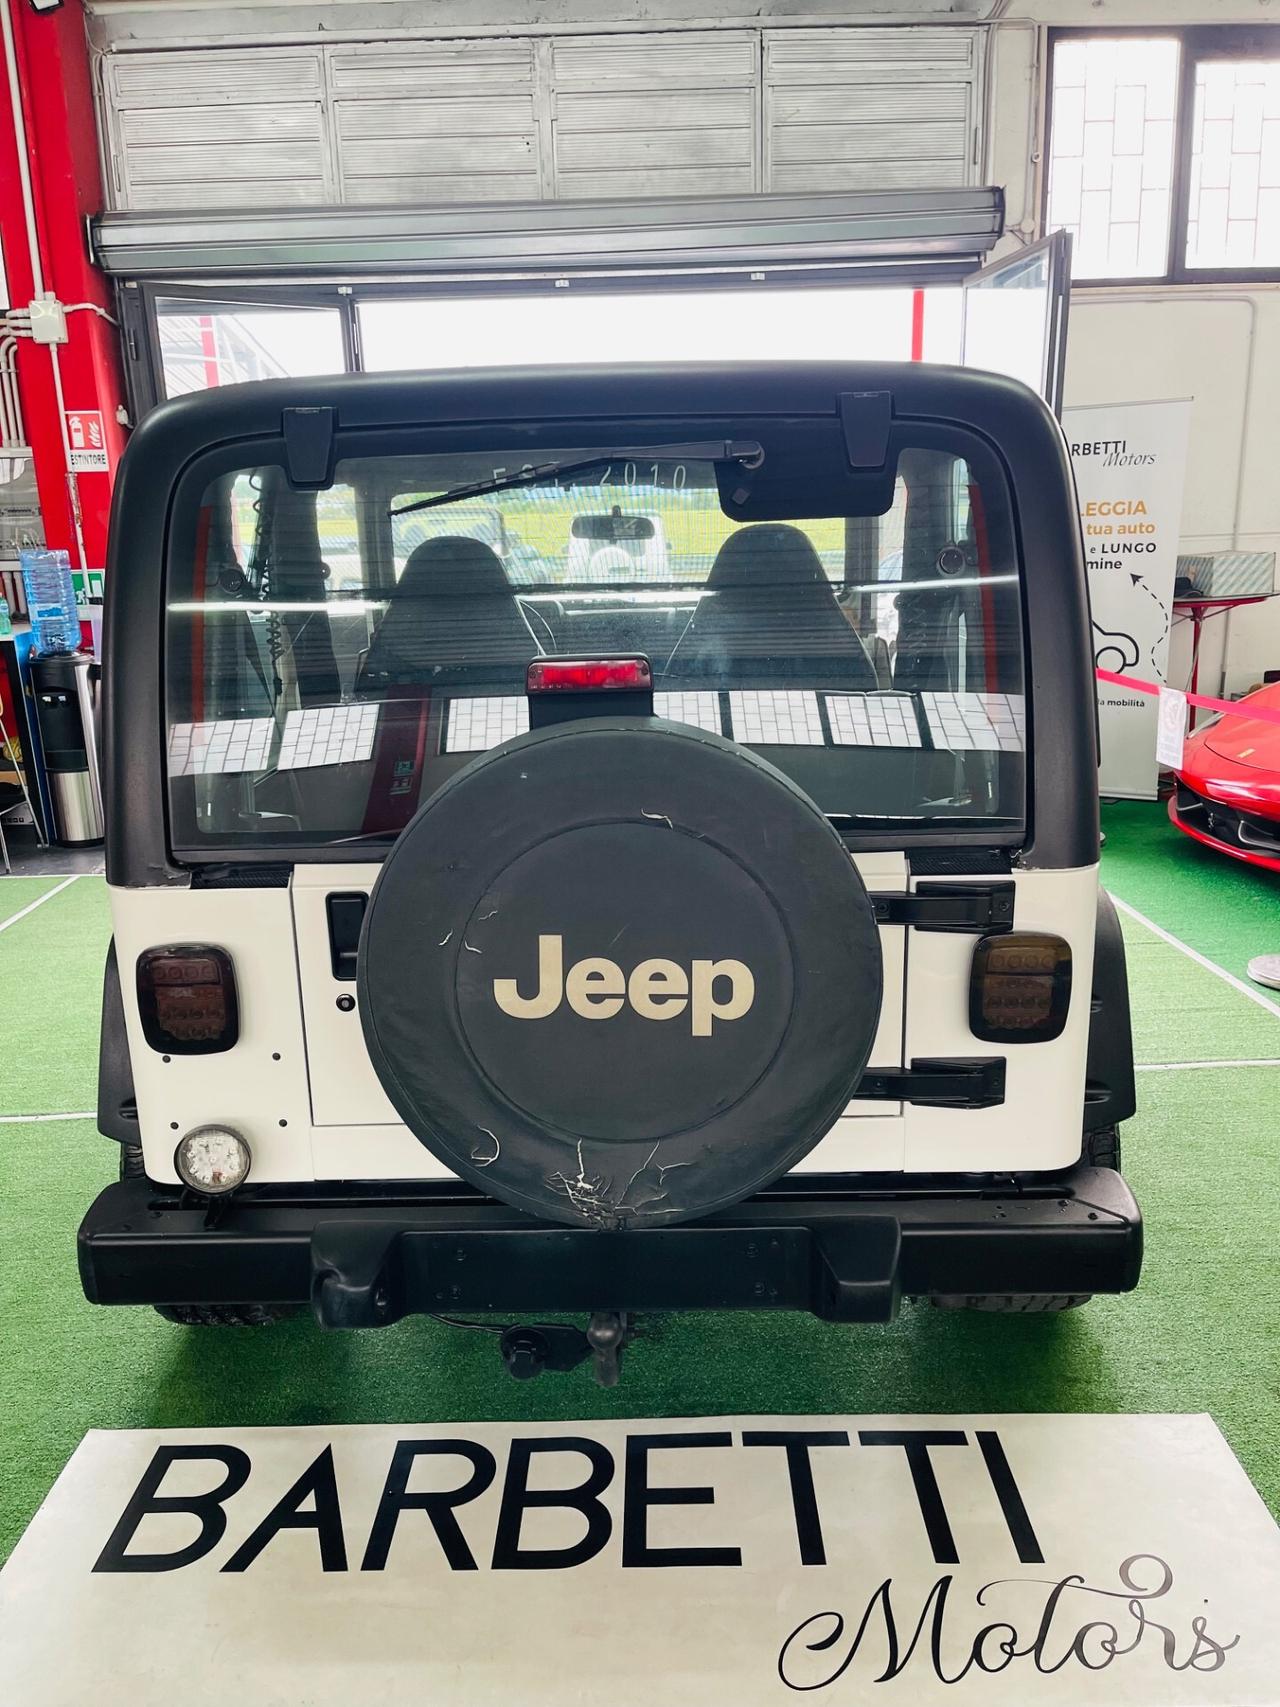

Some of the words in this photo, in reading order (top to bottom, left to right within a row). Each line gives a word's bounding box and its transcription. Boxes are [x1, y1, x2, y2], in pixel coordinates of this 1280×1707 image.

[70, 454, 106, 465] ESTINTORE
[1102, 452, 1157, 467] Motors
[1086, 523, 1113, 535] tua
[1117, 522, 1155, 535] auto
[1089, 545, 1096, 554] e
[1101, 542, 1157, 554] LUNGO
[1107, 698, 1145, 708] mobilità
[493, 934, 755, 1037] Jeep
[91, 1429, 1045, 1573] BARBETTI
[778, 1553, 1241, 1692] Motors
